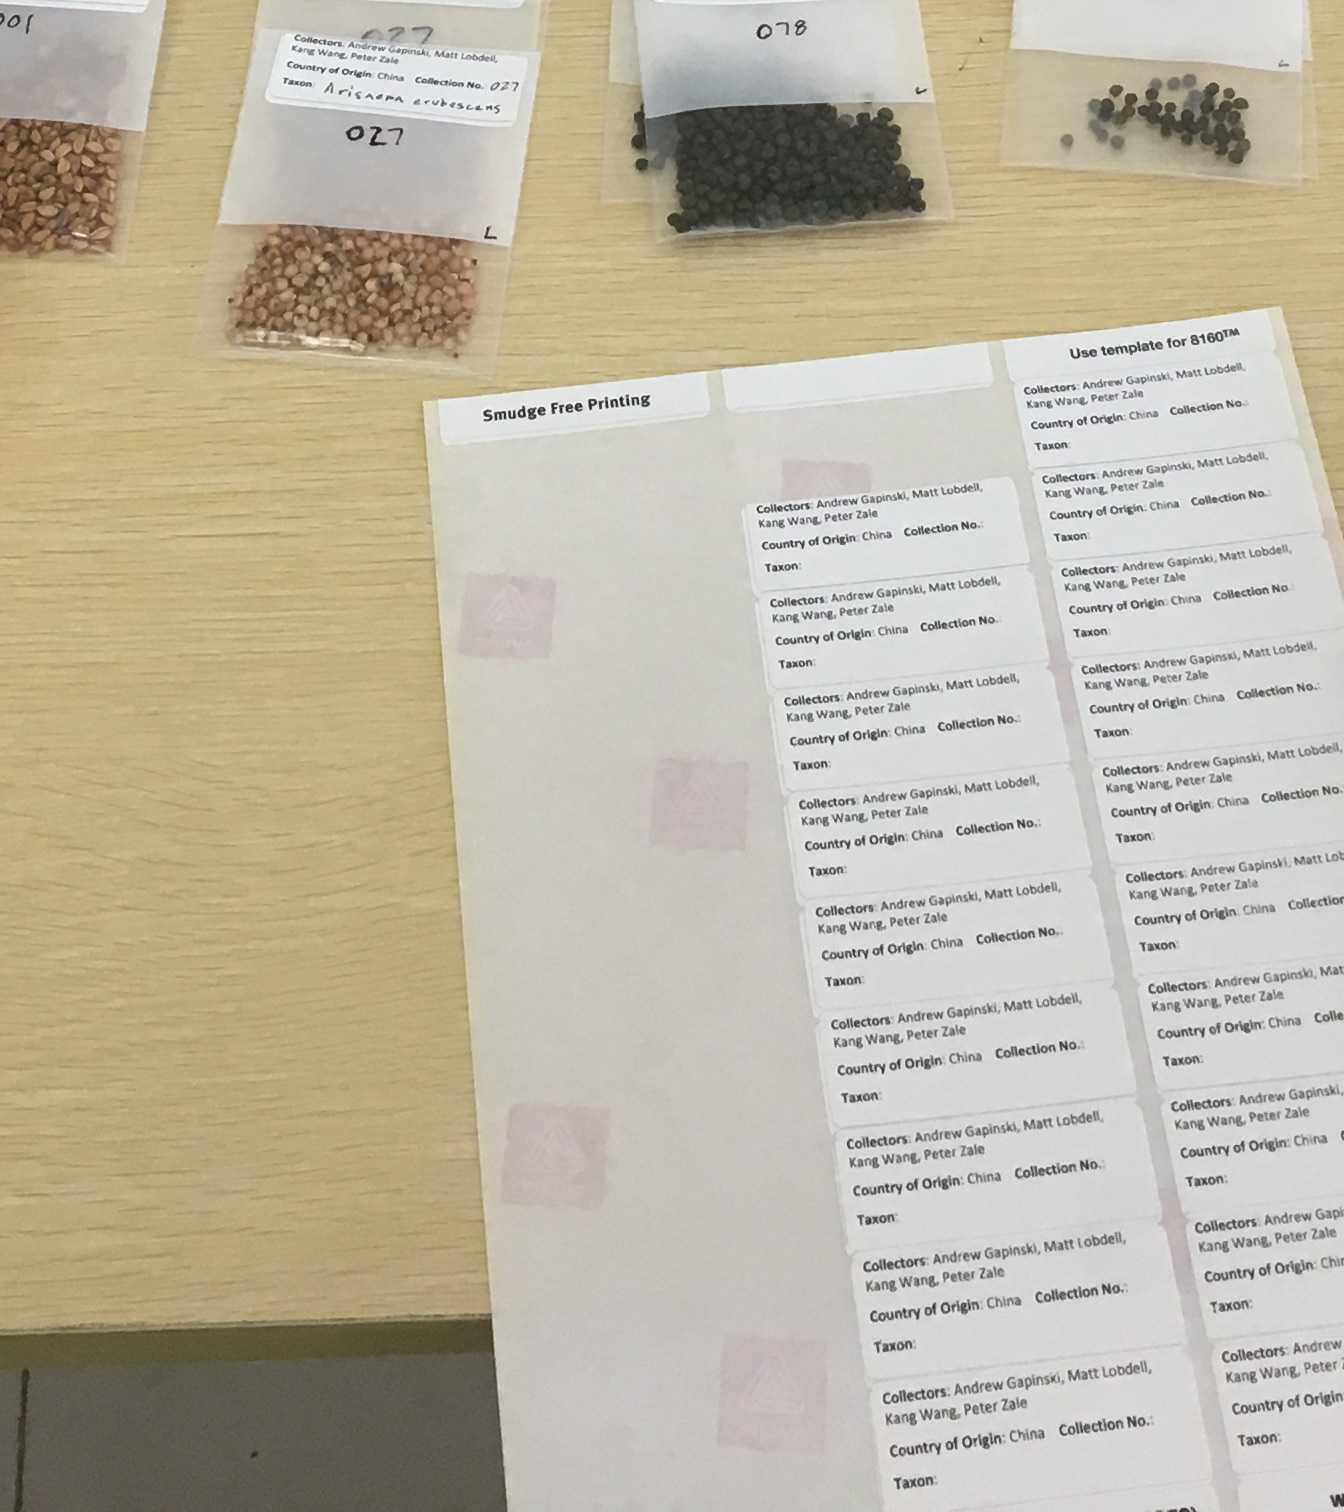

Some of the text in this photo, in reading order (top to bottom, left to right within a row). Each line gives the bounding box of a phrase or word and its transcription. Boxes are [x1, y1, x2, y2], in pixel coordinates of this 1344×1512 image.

[756, 19, 807, 40] 078
[291, 45, 315, 55] Kang
[351, 52, 378, 63] Peter
[379, 55, 400, 65] Zale
[348, 40, 387, 54] Andrew
[434, 50, 458, 60] Matt
[489, 80, 520, 93] 027
[345, 126, 405, 147] 027
[1070, 347, 1098, 360] Use
[1101, 340, 1164, 357] template
[1166, 336, 1187, 349] for
[1024, 362, 1247, 396] Collectors: Andrew Gapinski, Matt Lobdell,
[481, 392, 652, 425] Smudge Free Printing
[1026, 389, 1144, 410] Kang Wang, Peter Zale
[1030, 418, 1074, 431] Country
[1076, 416, 1088, 426] of
[1091, 413, 1127, 425] Origin:
[1129, 410, 1159, 420] China
[1169, 402, 1224, 416] Collection
[1034, 441, 1071, 452] Taxon:
[1221, 1345, 1290, 1364] Collectors:
[1293, 1338, 1342, 1355] Andrew
[1225, 1371, 1258, 1384] Kang
[1259, 1364, 1301, 1380] Wang,
[1303, 1360, 1337, 1375] Peter
[1232, 1400, 1284, 1416] Country
[1287, 1396, 1301, 1409] of
[1237, 1432, 1281, 1447] Taxon:
